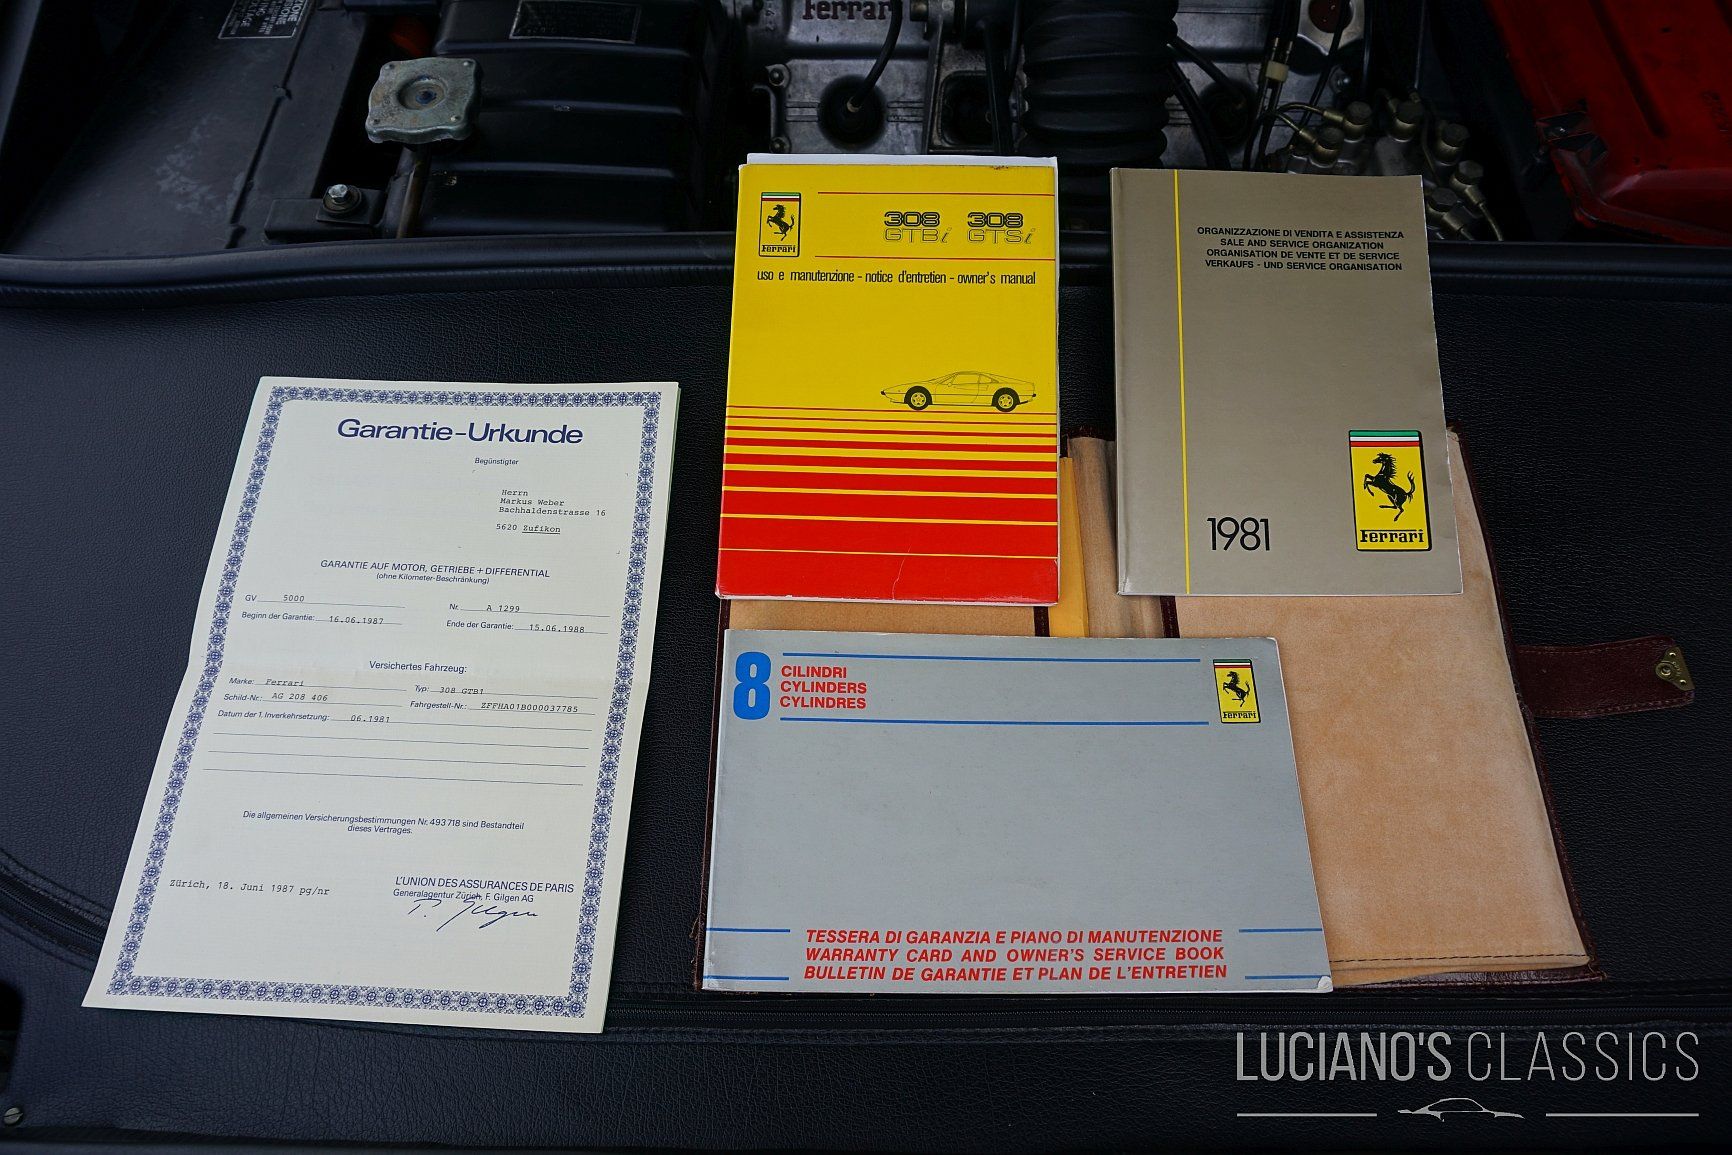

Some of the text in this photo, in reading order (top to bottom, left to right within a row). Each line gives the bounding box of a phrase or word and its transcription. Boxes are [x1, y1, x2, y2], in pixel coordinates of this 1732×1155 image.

[802, 0, 893, 20] Ferrar
[884, 211, 1023, 228] 308 308
[884, 226, 1036, 245] GTBi GTSi
[1197, 227, 1281, 237] ORGANIZZAZIONE
[1294, 230, 1334, 238] VENDITA
[1344, 231, 1404, 239] ASSISTENZA
[761, 244, 796, 253] Ferrari
[1220, 238, 1384, 250] SALE AND SERVICE ORGANIZATION
[1206, 249, 1400, 260] ORGANISATION DE VENTE ET DE SERVICE
[1205, 259, 1254, 269] VERKAUFS
[1264, 261, 1284, 269] UND
[1286, 261, 1326, 270] SERVICE
[1329, 262, 1402, 271] ORGANISATION
[757, 270, 774, 281] uso
[778, 272, 785, 281] e
[790, 270, 854, 283] manutenzione
[865, 270, 893, 283] notice
[898, 270, 947, 284] d'entretien
[957, 271, 996, 285] owner's
[1000, 271, 1036, 285] manual
[337, 418, 584, 444] Garantie-Urkunde
[474, 457, 519, 467] Begünstigter
[501, 489, 529, 497] Herrn
[500, 498, 565, 507] Markus Weber
[499, 507, 590, 516] Bachhaldenstrasse
[496, 524, 561, 534] 5620 Zufikon
[1206, 516, 1271, 551] 1981
[1359, 529, 1424, 543] Ferrari
[320, 560, 368, 570] GARANTIE
[371, 562, 390, 571] AUF
[392, 563, 428, 573] MOTOR,
[430, 565, 475, 574] GETRIEBE
[485, 567, 551, 578] DIFFERENTIAL
[376, 572, 490, 585] (ohne Kilometer-Beschränkung)
[245, 594, 305, 602] GV 5000
[449, 603, 459, 611] Nr.
[498, 605, 520, 613] 1299
[241, 611, 384, 625] Beginn der Garantie: 16.06.1987
[446, 620, 585, 633] Ende der Garantie: 15.06.1988
[369, 660, 468, 674] Versichertes Fahrzeug:
[781, 665, 847, 679] CILINDRI
[229, 677, 304, 687] Marke: Ferrari
[732, 651, 771, 721] 8
[780, 680, 868, 694] CYLINDERS
[415, 685, 430, 693] Typ:
[439, 686, 456, 694] 308
[272, 692, 284, 700] AG
[289, 693, 306, 701] 208
[311, 694, 329, 702] 406
[779, 695, 867, 709] CYLINDRES
[218, 710, 243, 718] Datum
[264, 712, 330, 722] Inverkehrsetzung:
[350, 715, 390, 723] 06.1981
[1222, 711, 1257, 719] Ferrari
[242, 810, 255, 819] Die
[257, 811, 303, 823] allgemeinen
[304, 813, 416, 827] Versicherungsbestimmungen
[462, 820, 479, 828] sind
[480, 820, 524, 830] Bestandteil
[347, 825, 413, 835] dieses Vertrages.
[169, 879, 330, 896] Zürich, 18. Juni 1987 pg/nr
[395, 876, 574, 893] L'UNION DES ASSURANCES DE PARIS
[393, 889, 454, 899] Generalagentur
[493, 893, 519, 903] Gilgen
[521, 895, 534, 903] AG
[806, 929, 1223, 944] TESSERA DI GARANZIA E PIANO DI MANUTENZIONE
[805, 947, 1225, 962] WARRANTY CARD AND OWNER'S SERVICE BOOK
[804, 965, 1227, 981] BULLETIN DE GARANTIE ET PLAN DE L'ENTRETIEN
